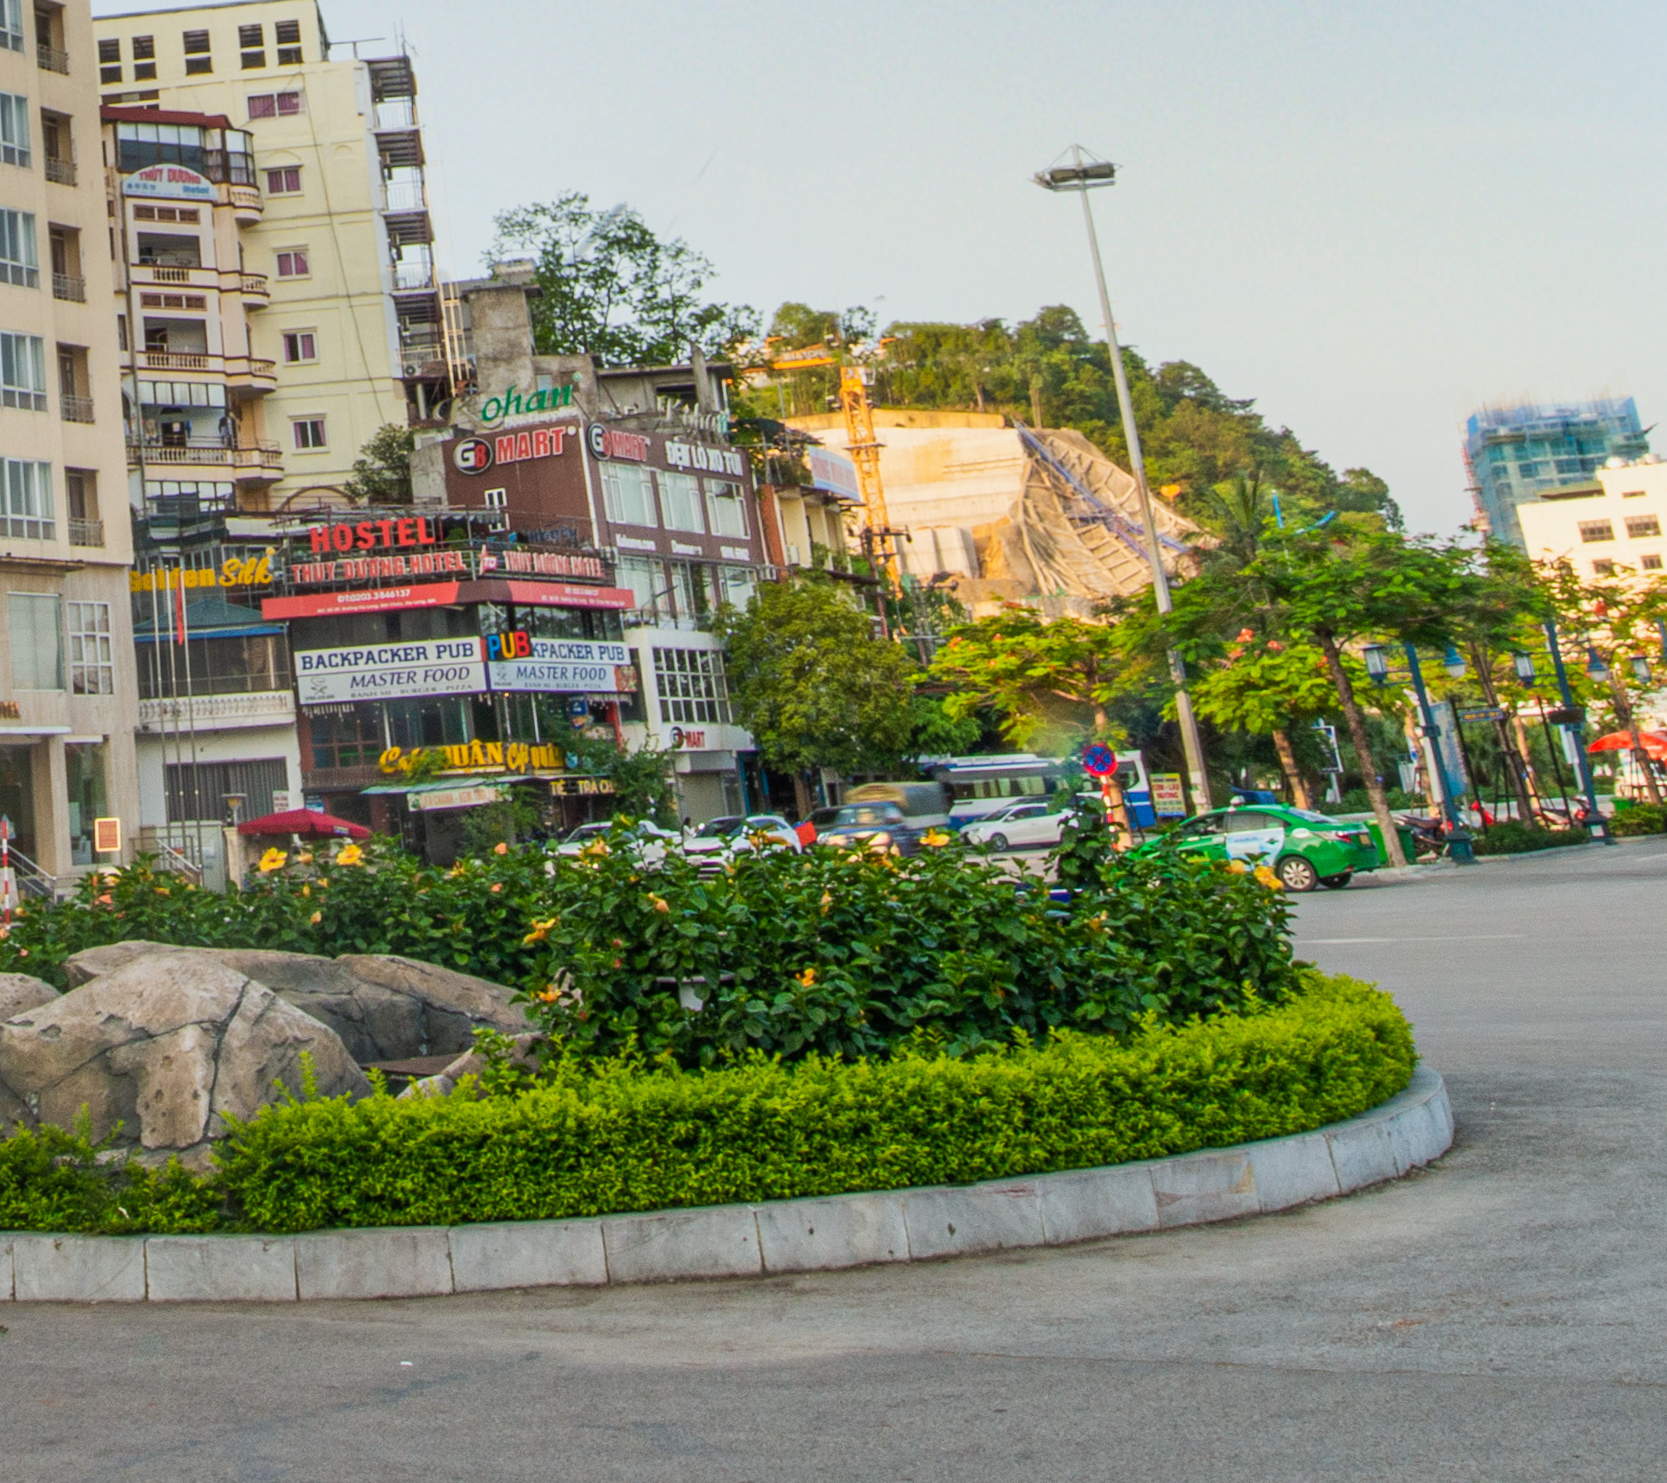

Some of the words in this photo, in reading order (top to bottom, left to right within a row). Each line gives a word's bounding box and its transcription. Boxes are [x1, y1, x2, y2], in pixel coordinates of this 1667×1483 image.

[458, 441, 487, 469] G8
[495, 425, 567, 465] MART
[310, 516, 436, 553] HOSTEL
[219, 556, 274, 587] Silk
[409, 550, 467, 575] HOTEL
[301, 646, 429, 670] BACKPACKER
[435, 642, 475, 659] PUB
[487, 631, 531, 660] PUB
[598, 645, 625, 661] PUB
[350, 670, 418, 689] MASTER
[423, 666, 471, 683] FOOD
[516, 665, 569, 681] MASTER
[572, 666, 607, 681] FOOD
